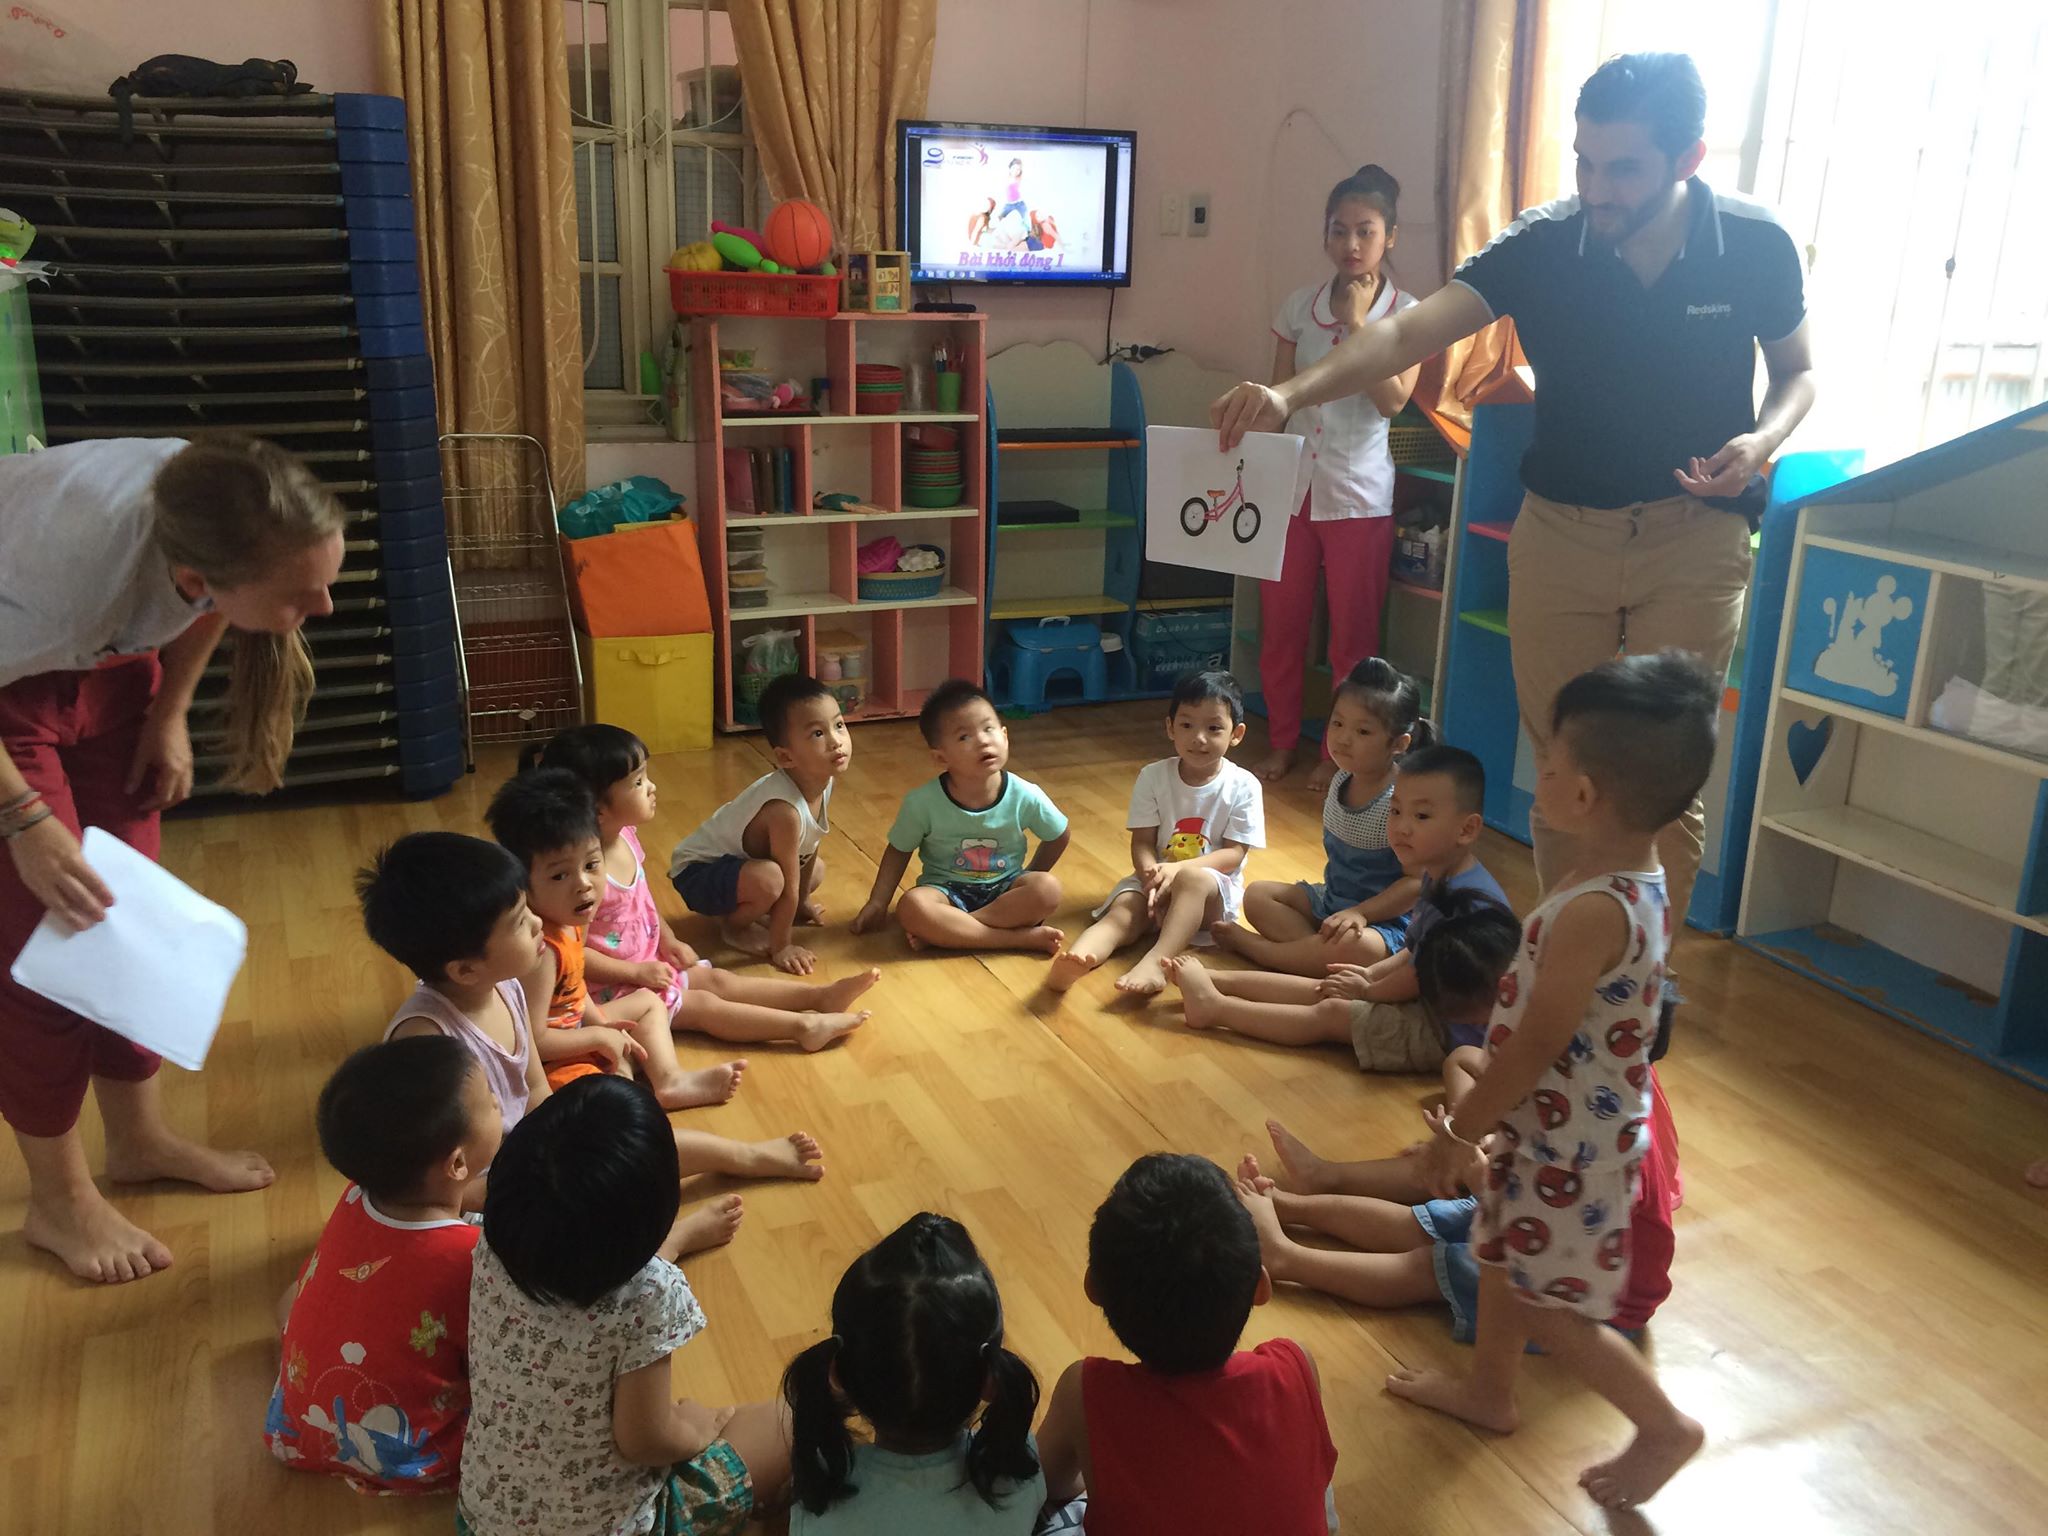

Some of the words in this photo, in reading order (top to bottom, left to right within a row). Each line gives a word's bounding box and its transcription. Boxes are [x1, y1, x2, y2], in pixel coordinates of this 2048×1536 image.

[959, 251, 984, 266] Bài
[986, 251, 1017, 268] khởi
[1019, 252, 1053, 270] động
[1055, 253, 1064, 268] 1
[1156, 624, 1190, 633] Double
[1193, 623, 1200, 632] A
